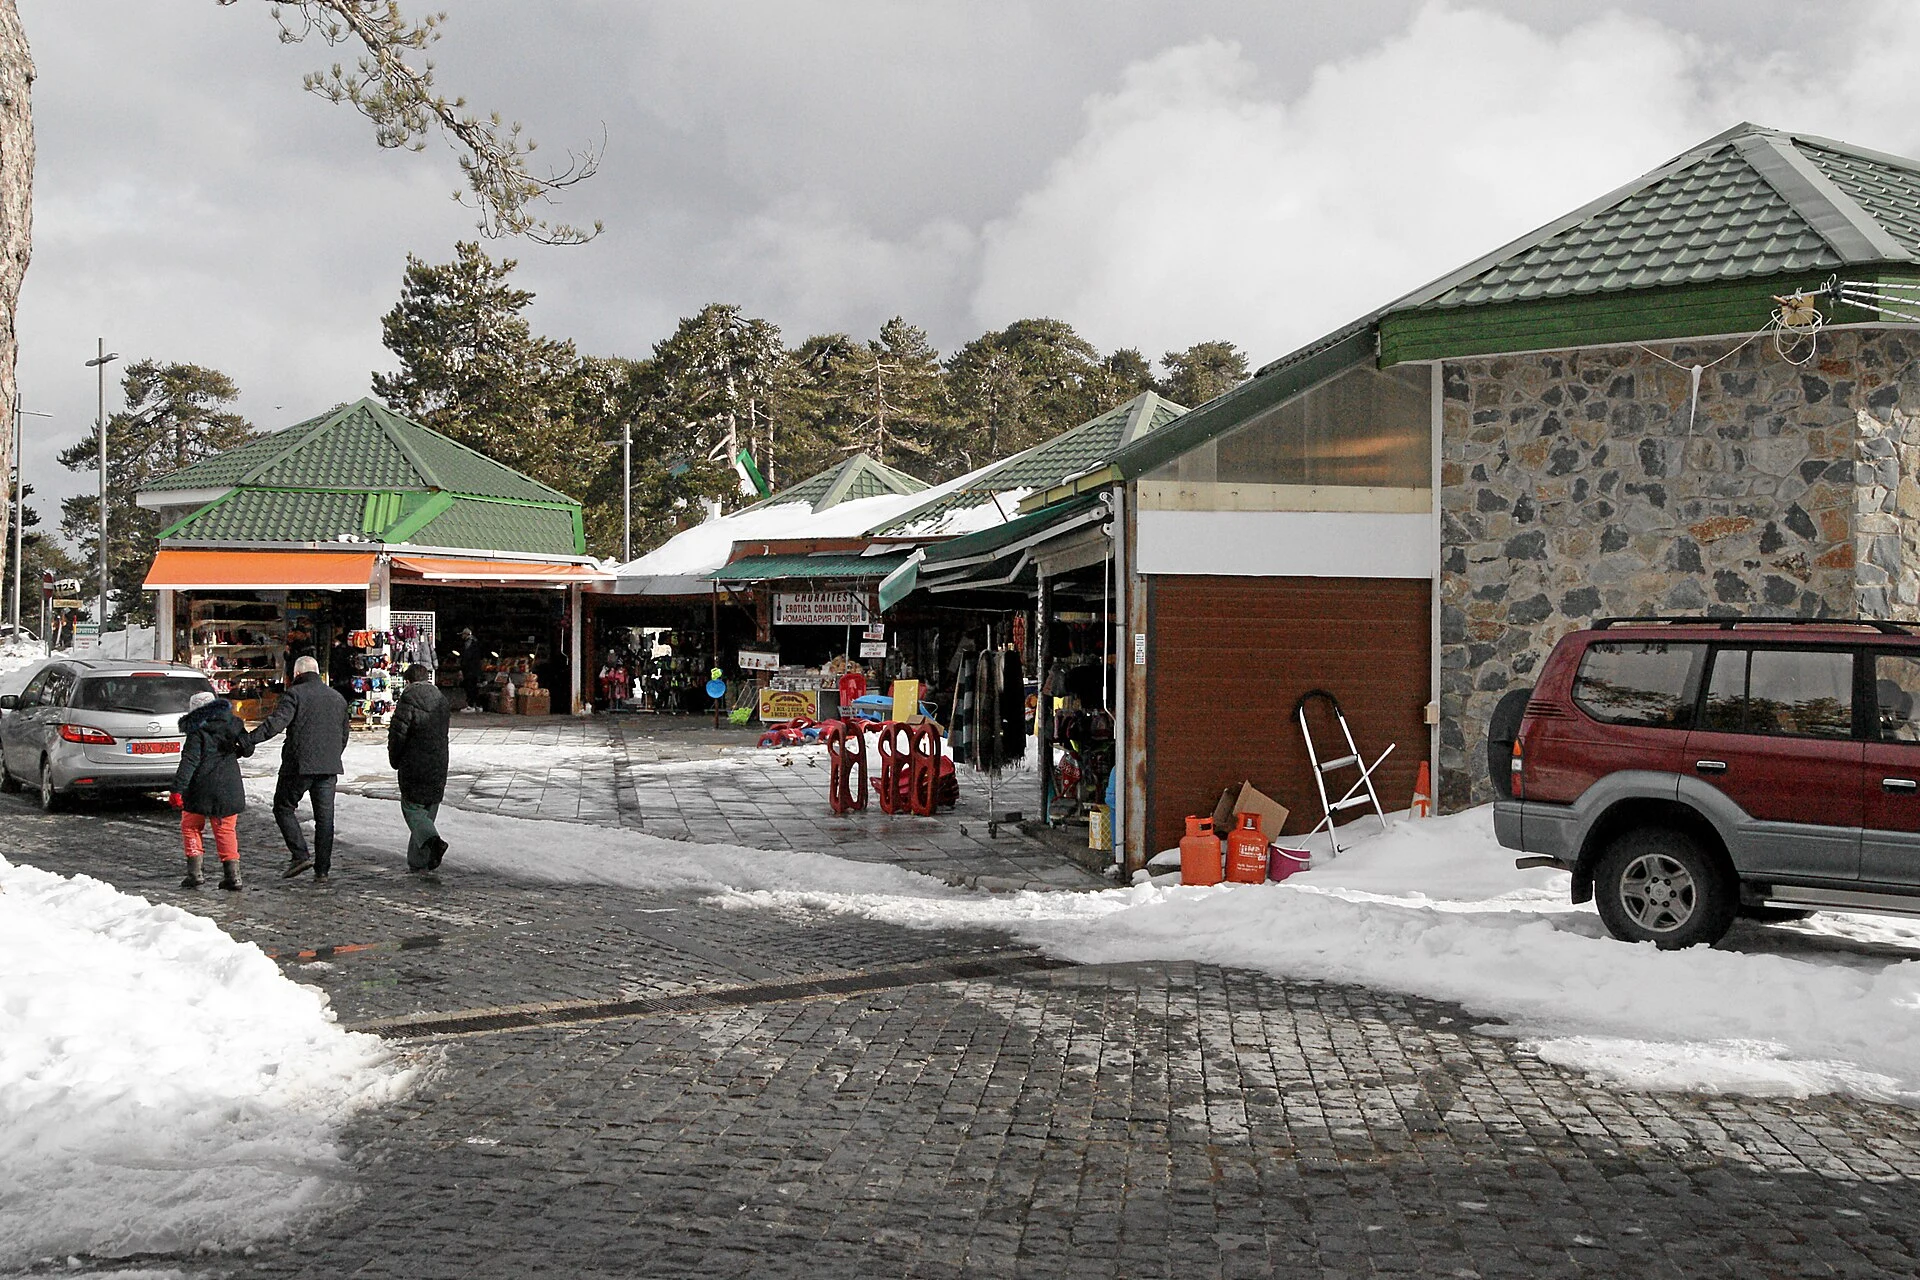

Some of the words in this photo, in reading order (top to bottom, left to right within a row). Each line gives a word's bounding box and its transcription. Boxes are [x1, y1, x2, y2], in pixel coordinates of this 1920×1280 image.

[53, 582, 76, 592] 1725
[785, 604, 812, 613] EROTICA
[159, 743, 175, 752] 759
